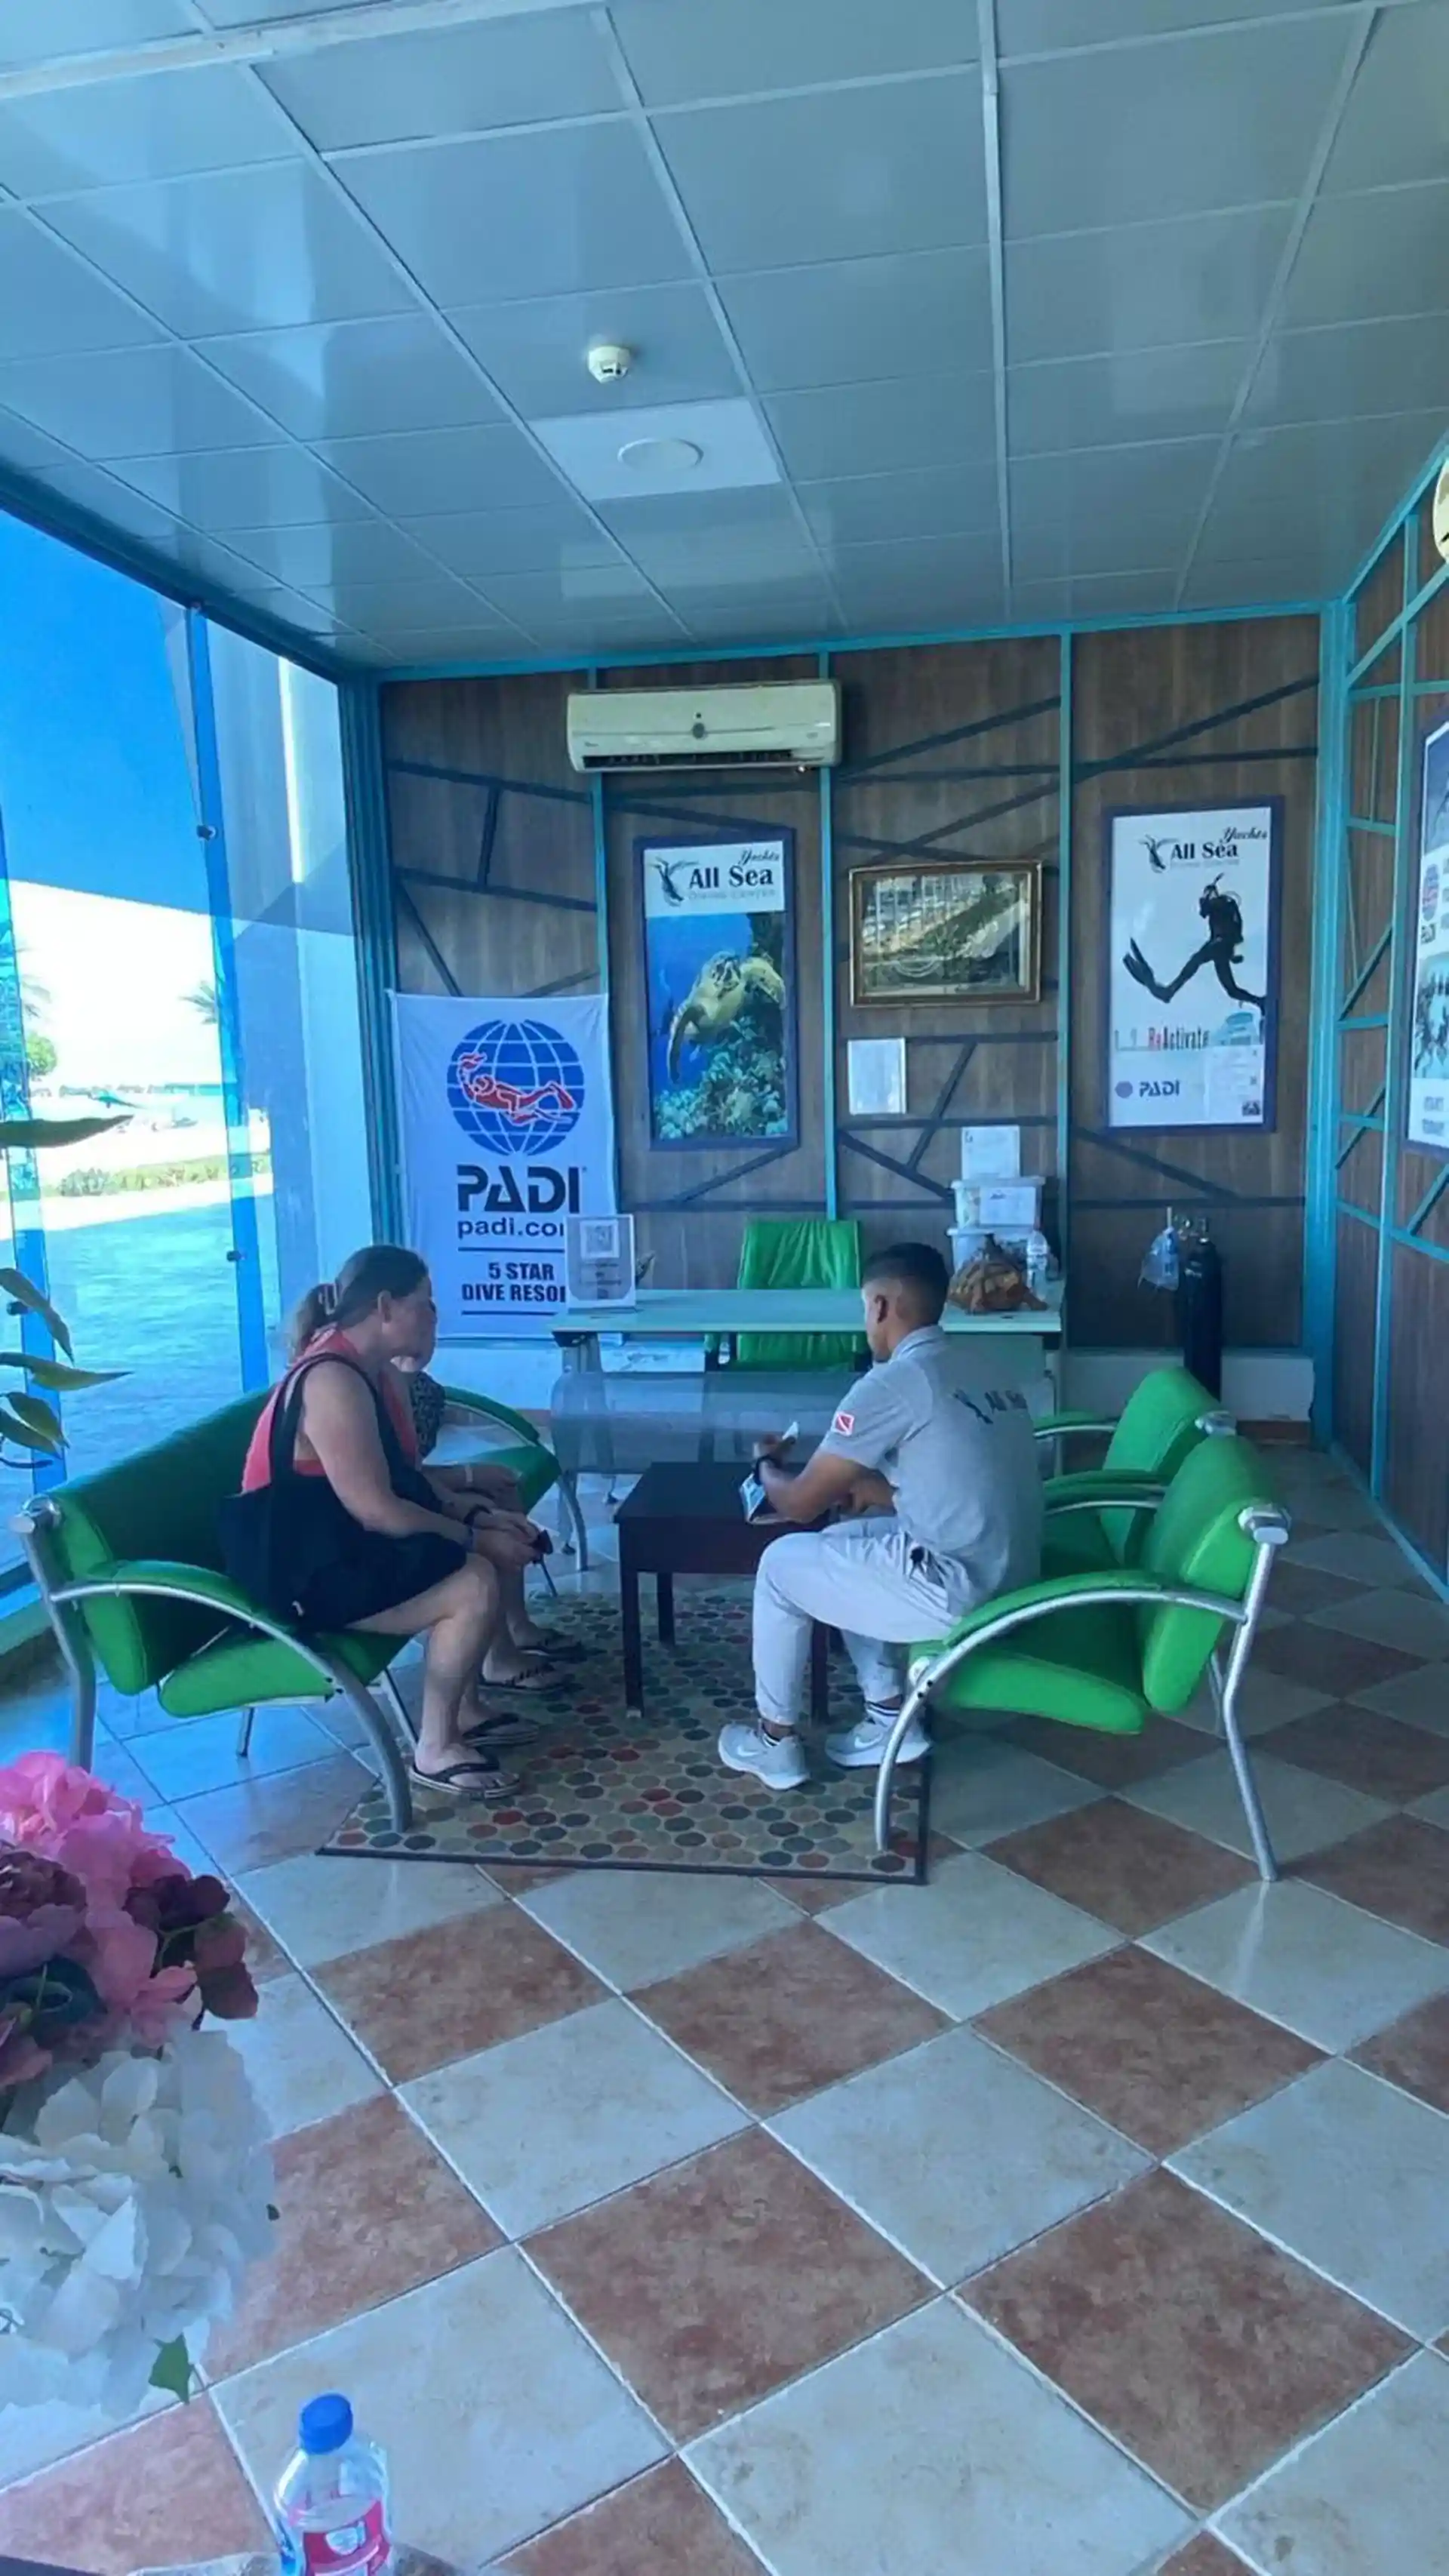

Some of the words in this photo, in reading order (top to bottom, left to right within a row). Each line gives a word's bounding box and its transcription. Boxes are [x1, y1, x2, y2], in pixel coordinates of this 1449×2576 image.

[1171, 843, 1195, 860] All
[1201, 841, 1238, 859] Sea
[689, 866, 720, 889] All
[728, 865, 774, 887] Sea
[1139, 1079, 1181, 1097] PADI
[457, 1165, 580, 1213] PADI
[488, 1262, 500, 1279] 5
[505, 1262, 555, 1281] STAR
[462, 1284, 505, 1300] DIVE
[510, 1284, 565, 1303] RESO
